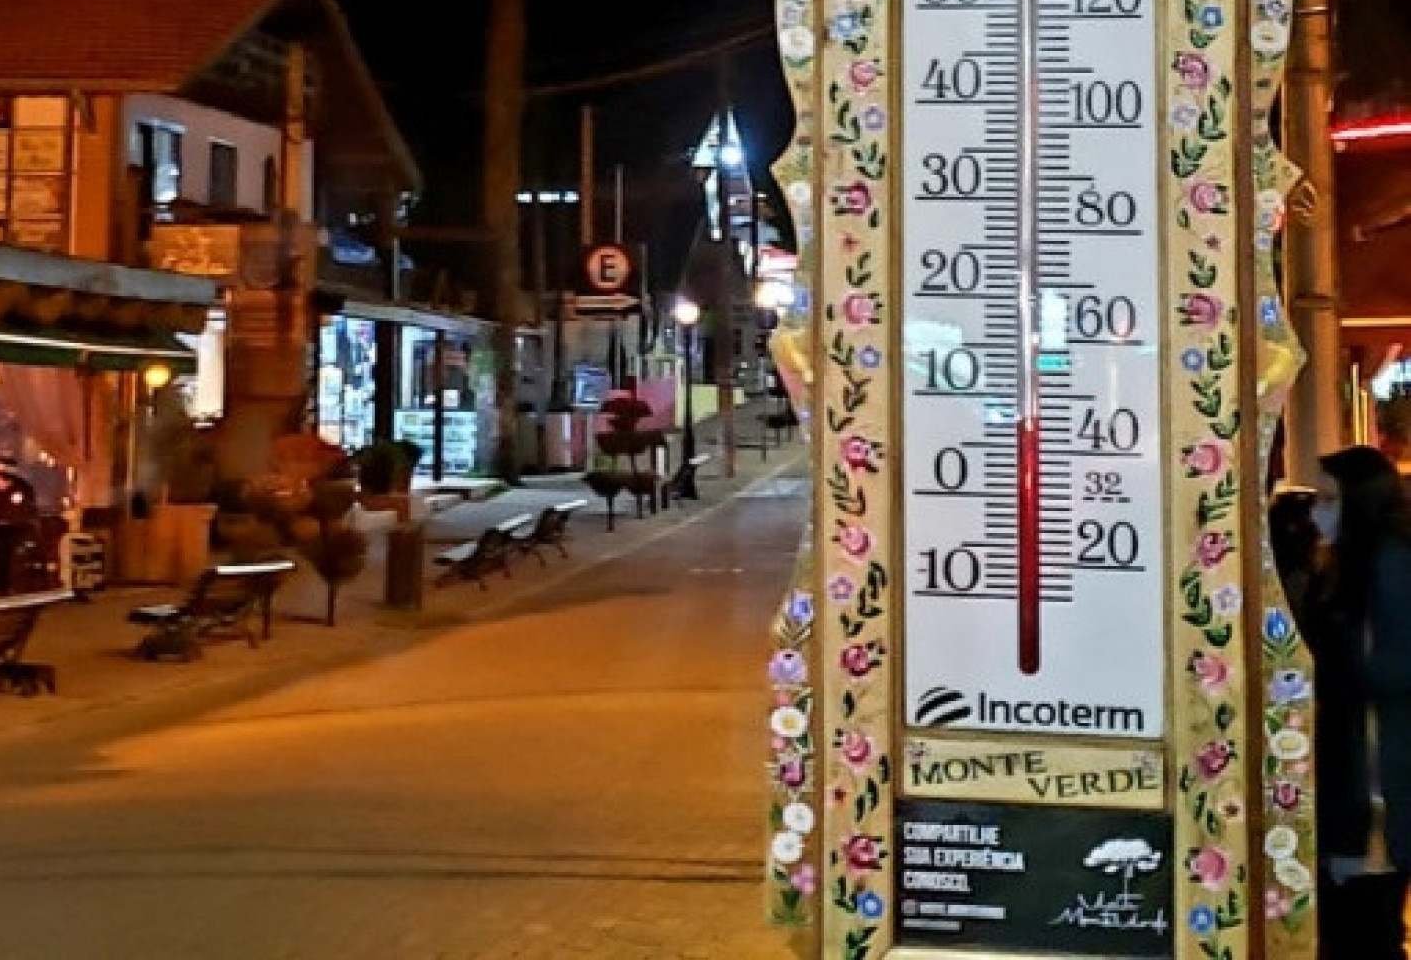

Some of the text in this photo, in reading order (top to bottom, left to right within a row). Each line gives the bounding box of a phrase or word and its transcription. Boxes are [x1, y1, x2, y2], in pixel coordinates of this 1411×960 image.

[920, 58, 982, 98] 40
[1069, 80, 1142, 123] 100
[922, 152, 981, 195] 30
[1075, 189, 1137, 227] 80
[599, 253, 617, 283] E
[920, 248, 980, 291] 20
[1075, 295, 1136, 338] 60
[919, 347, 980, 391] 10
[1077, 407, 1140, 451] 40
[933, 447, 969, 490] 0
[1085, 471, 1123, 495] 32
[1077, 519, 1140, 565] 20
[977, 691, 1145, 732] Incoterm
[909, 749, 1158, 798] MONTE VERDE
